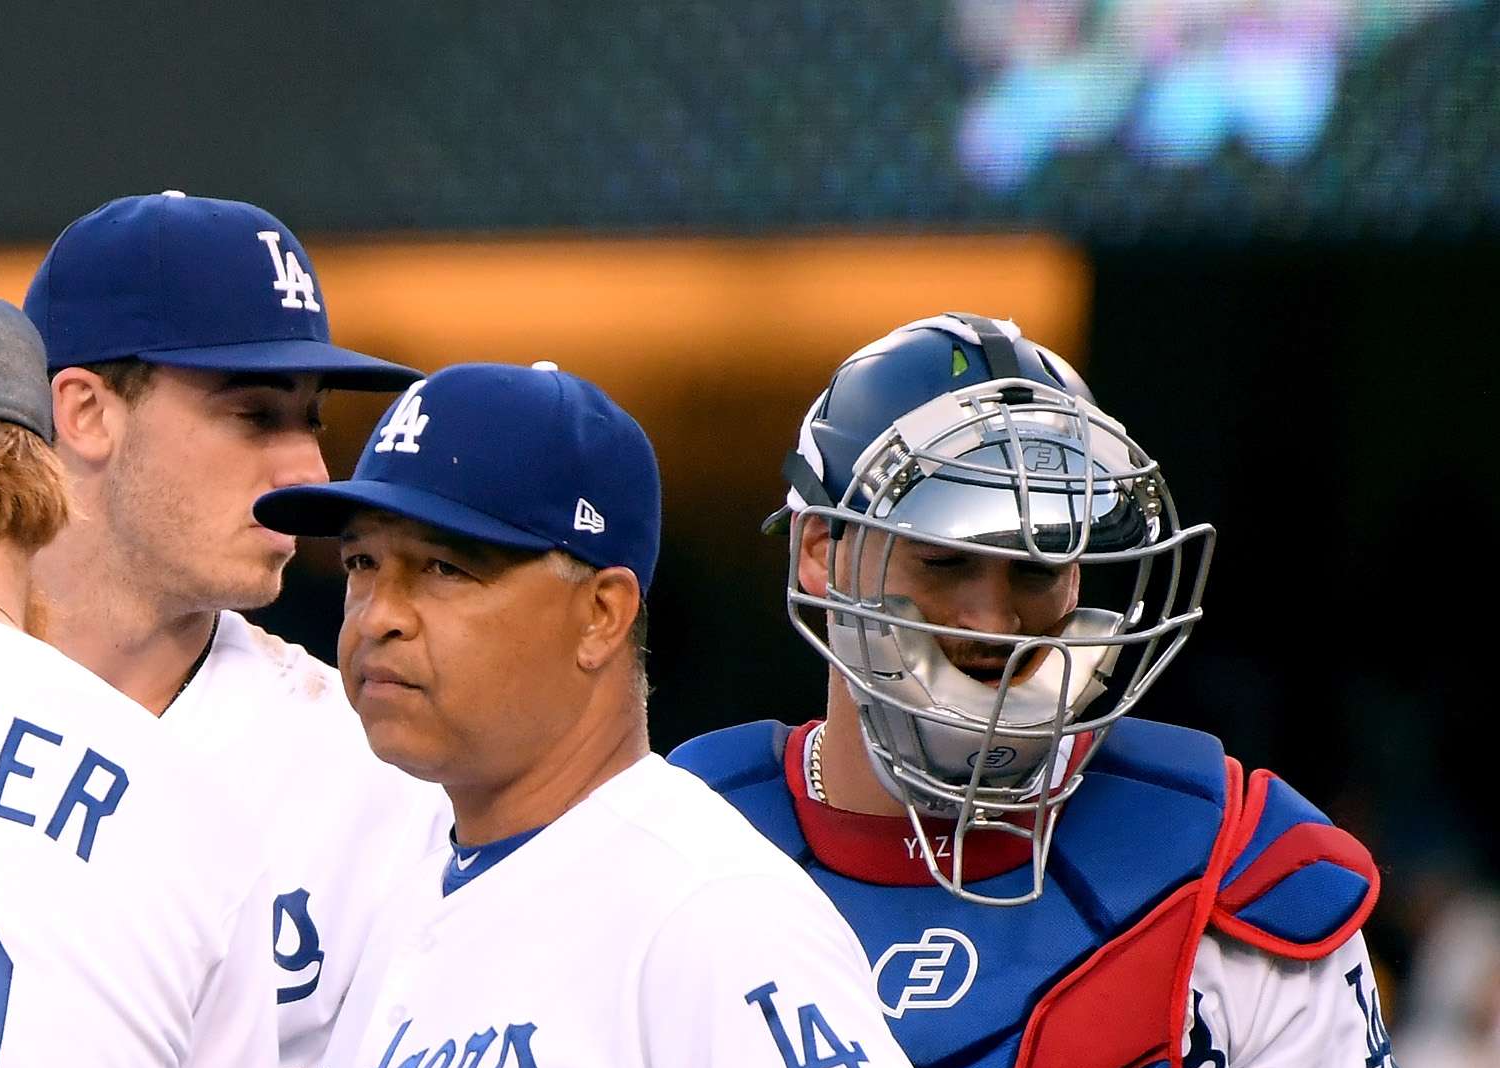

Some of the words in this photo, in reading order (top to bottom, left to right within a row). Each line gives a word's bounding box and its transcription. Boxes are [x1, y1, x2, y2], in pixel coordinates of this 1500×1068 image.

[257, 230, 321, 313] LA
[374, 379, 430, 454] LA
[903, 836, 951, 859] YZ
